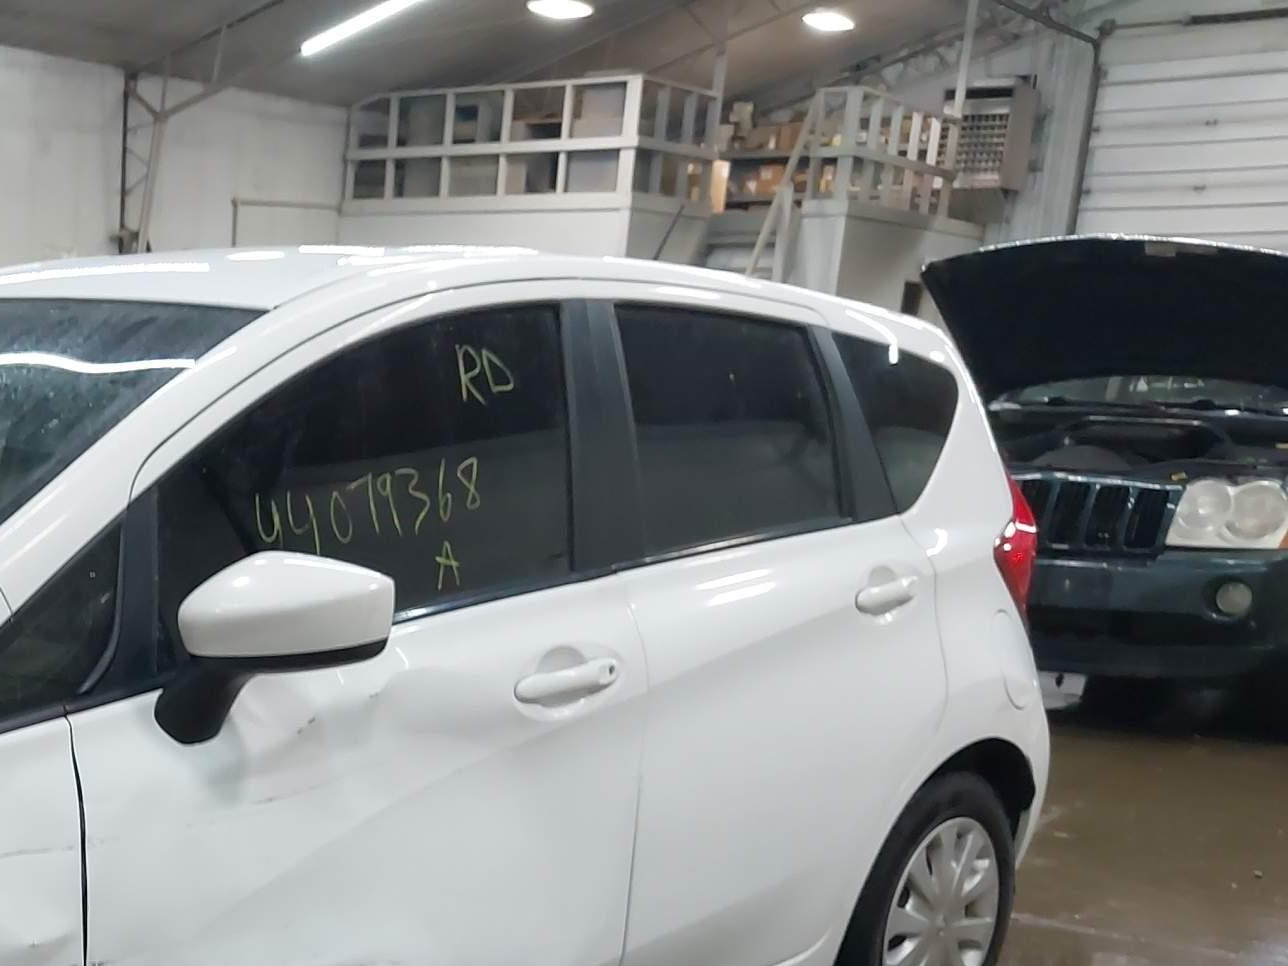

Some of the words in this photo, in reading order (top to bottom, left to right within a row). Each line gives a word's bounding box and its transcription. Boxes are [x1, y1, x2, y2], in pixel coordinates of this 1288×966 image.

[455, 344, 515, 407] RD
[254, 456, 481, 556] 44079368
[435, 540, 461, 591] A
